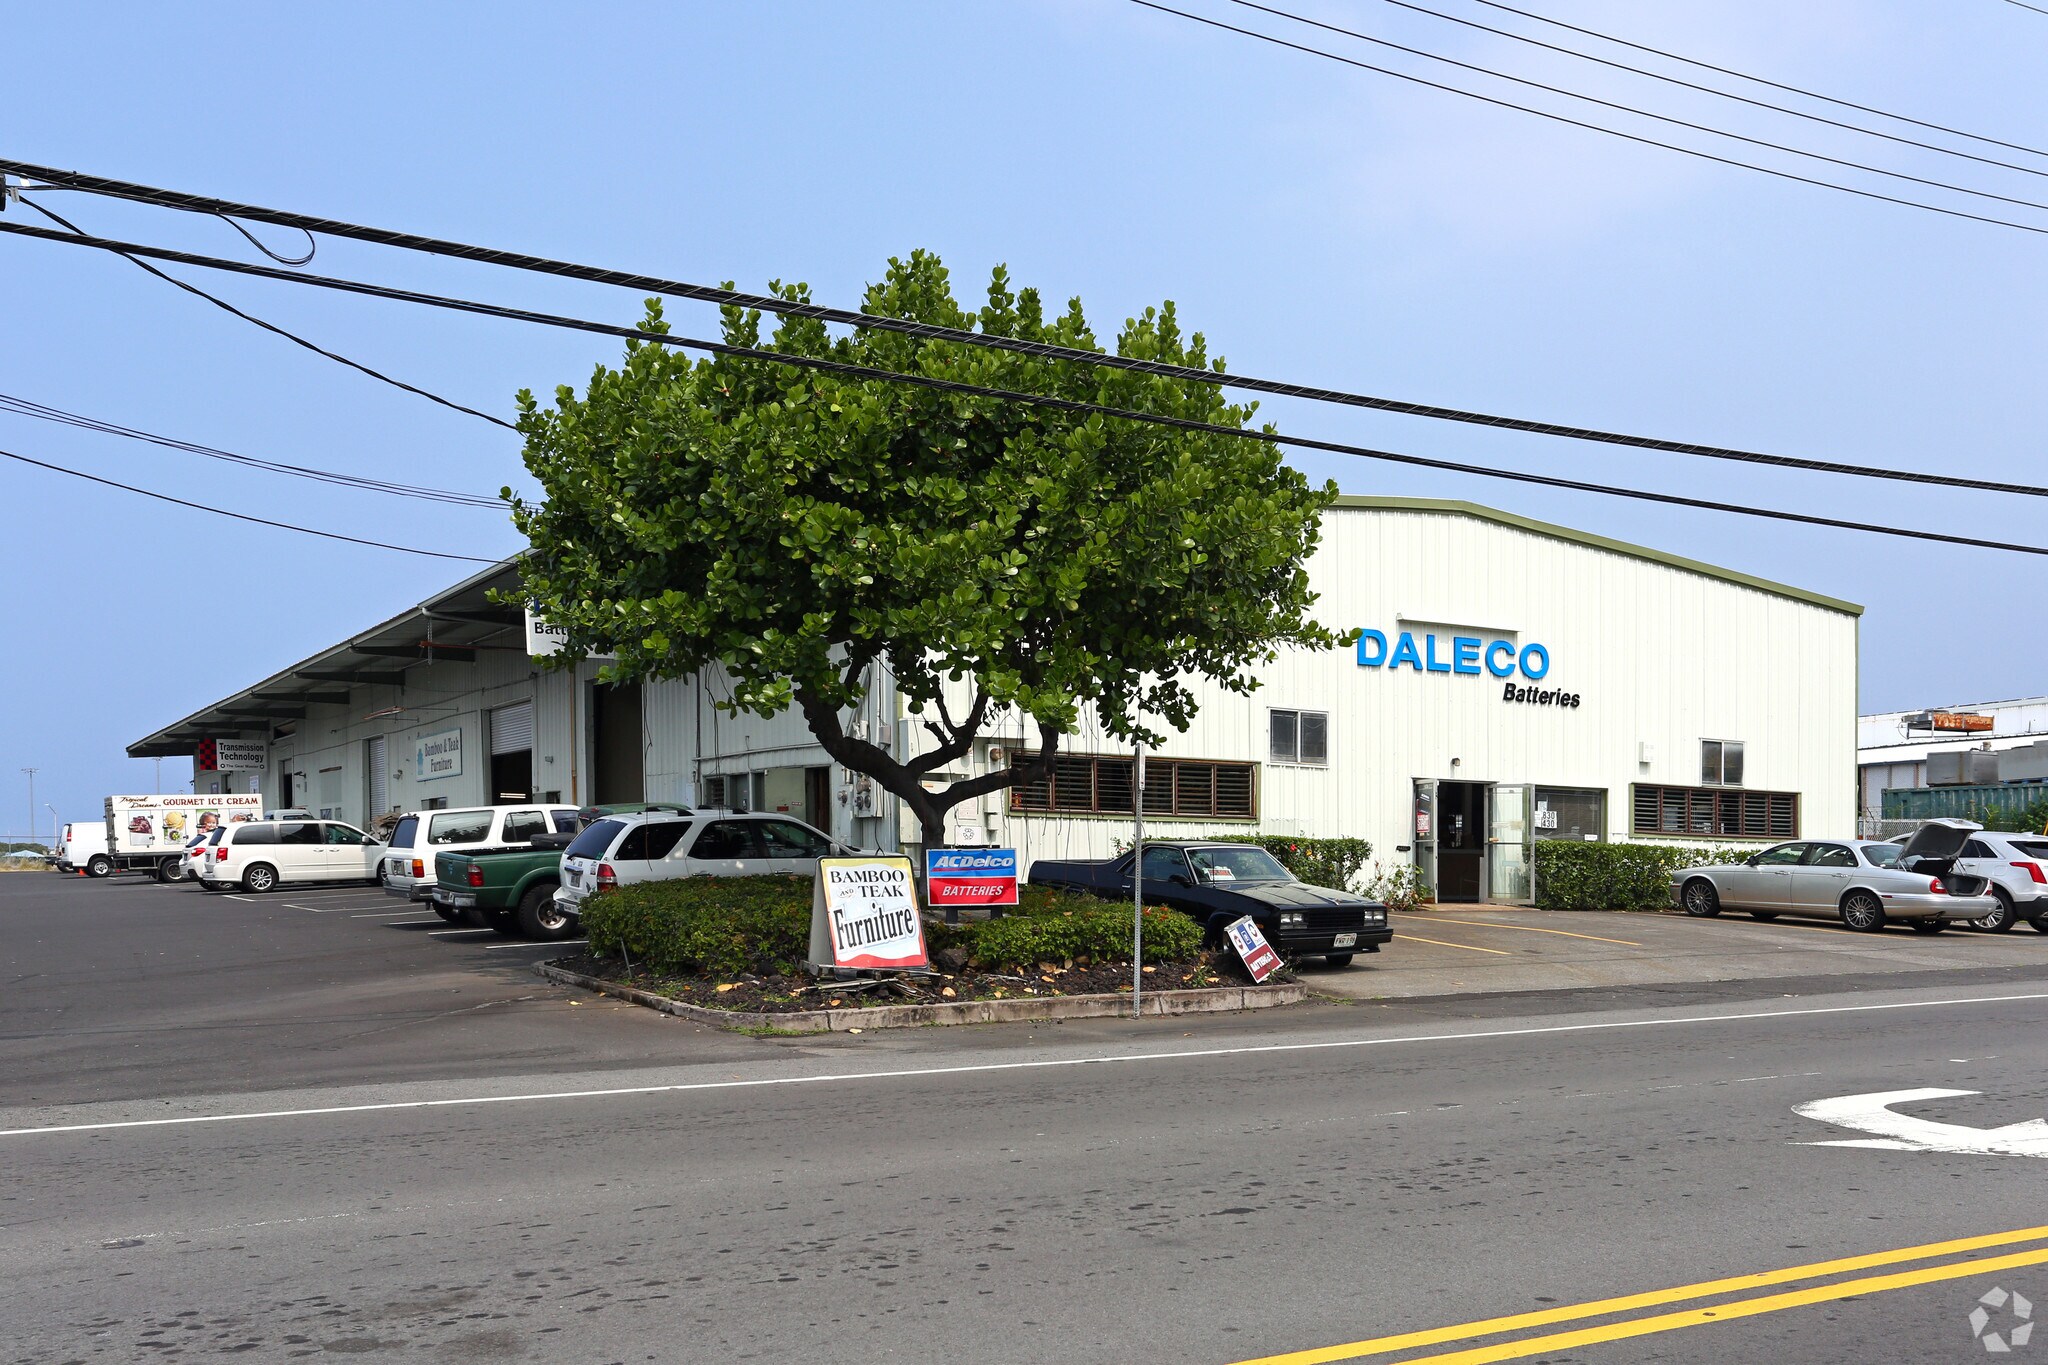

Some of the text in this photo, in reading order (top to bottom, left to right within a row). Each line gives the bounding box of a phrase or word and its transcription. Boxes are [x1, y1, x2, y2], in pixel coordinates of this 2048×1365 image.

[1357, 628, 1549, 679] DALECO
[1503, 683, 1580, 708] Batteries
[219, 743, 265, 752] Transmission
[425, 742, 443, 757] Bamboo
[448, 736, 459, 752] Teak
[219, 752, 264, 762] Technology
[431, 758, 452, 772] Furniture
[208, 797, 224, 805] ICE
[226, 797, 259, 805] CREAM
[1542, 811, 1556, 820] 830
[1541, 819, 1555, 828] 430
[935, 855, 1014, 868] ACDelco
[830, 870, 905, 884] BAMBOO
[840, 885, 904, 898] AND TEAK
[942, 885, 1004, 896] BATTERIES
[833, 902, 914, 950] Furniture
